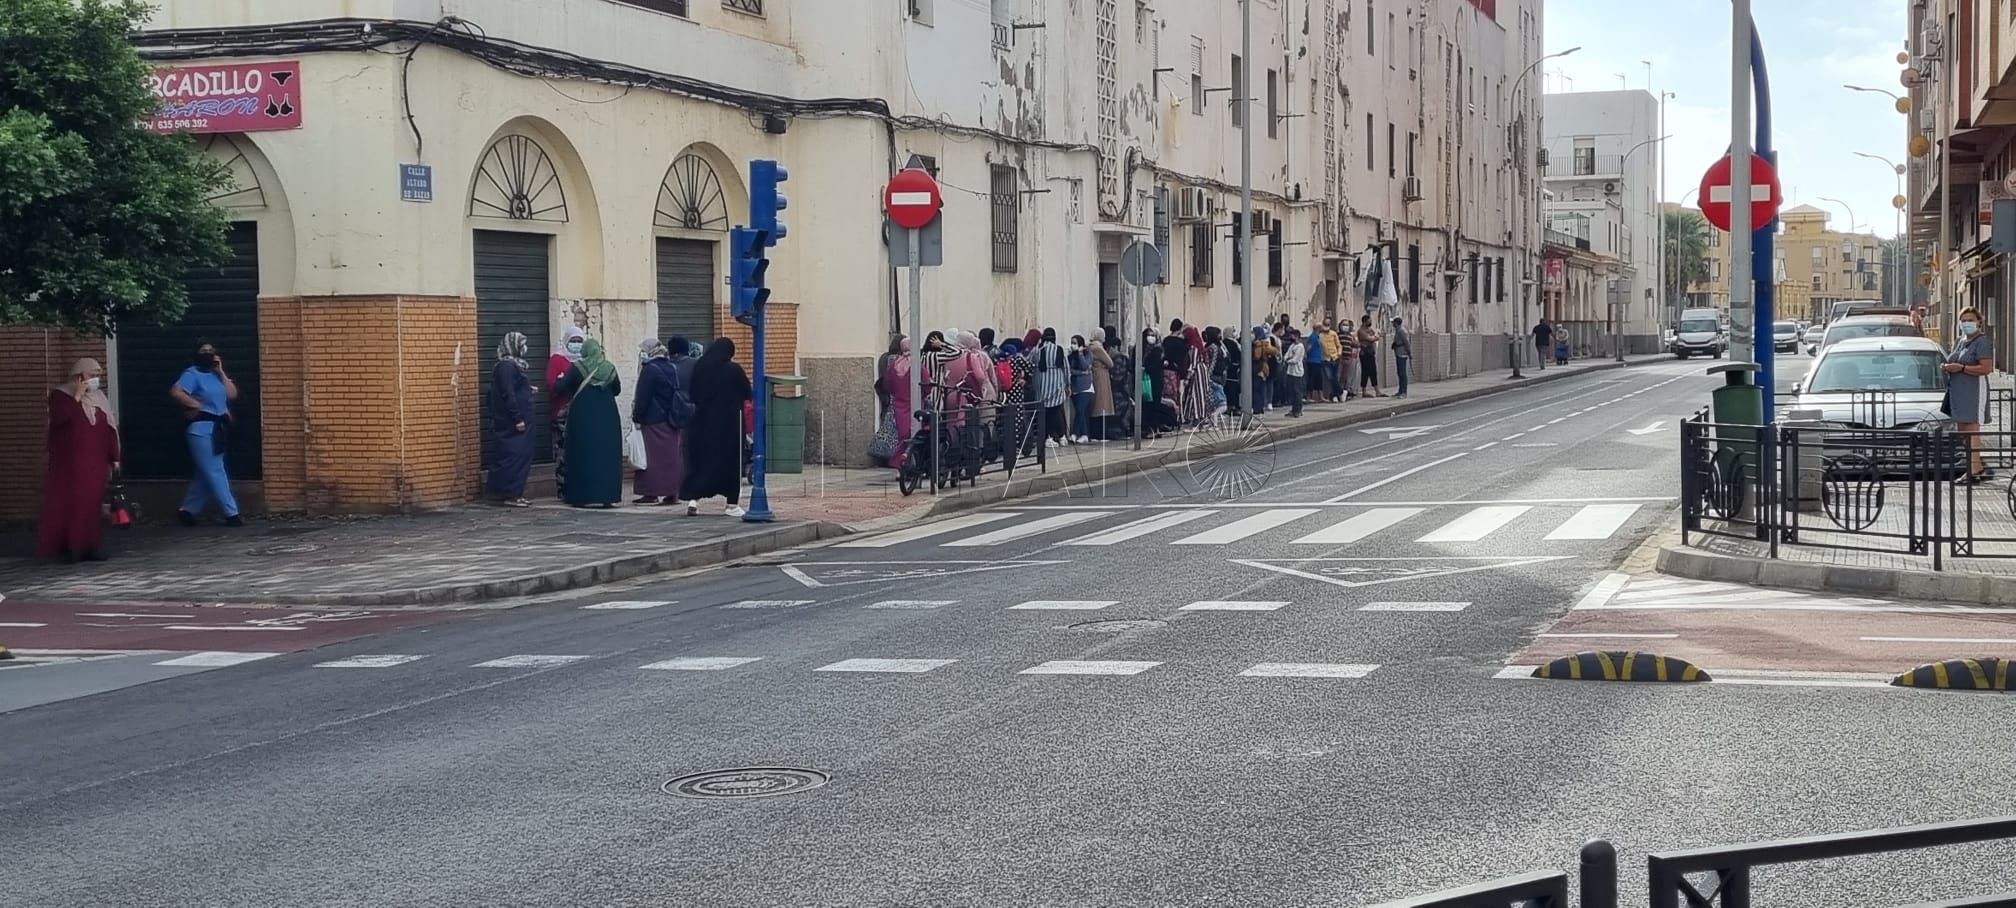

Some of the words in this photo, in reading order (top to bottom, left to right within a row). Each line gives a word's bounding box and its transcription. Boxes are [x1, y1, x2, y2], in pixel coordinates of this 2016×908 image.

[142, 70, 262, 97] RCADILLO
[158, 120, 173, 129] 635
[192, 118, 208, 127] 392
[408, 167, 425, 175] CALLE
[403, 190, 412, 198] DE
